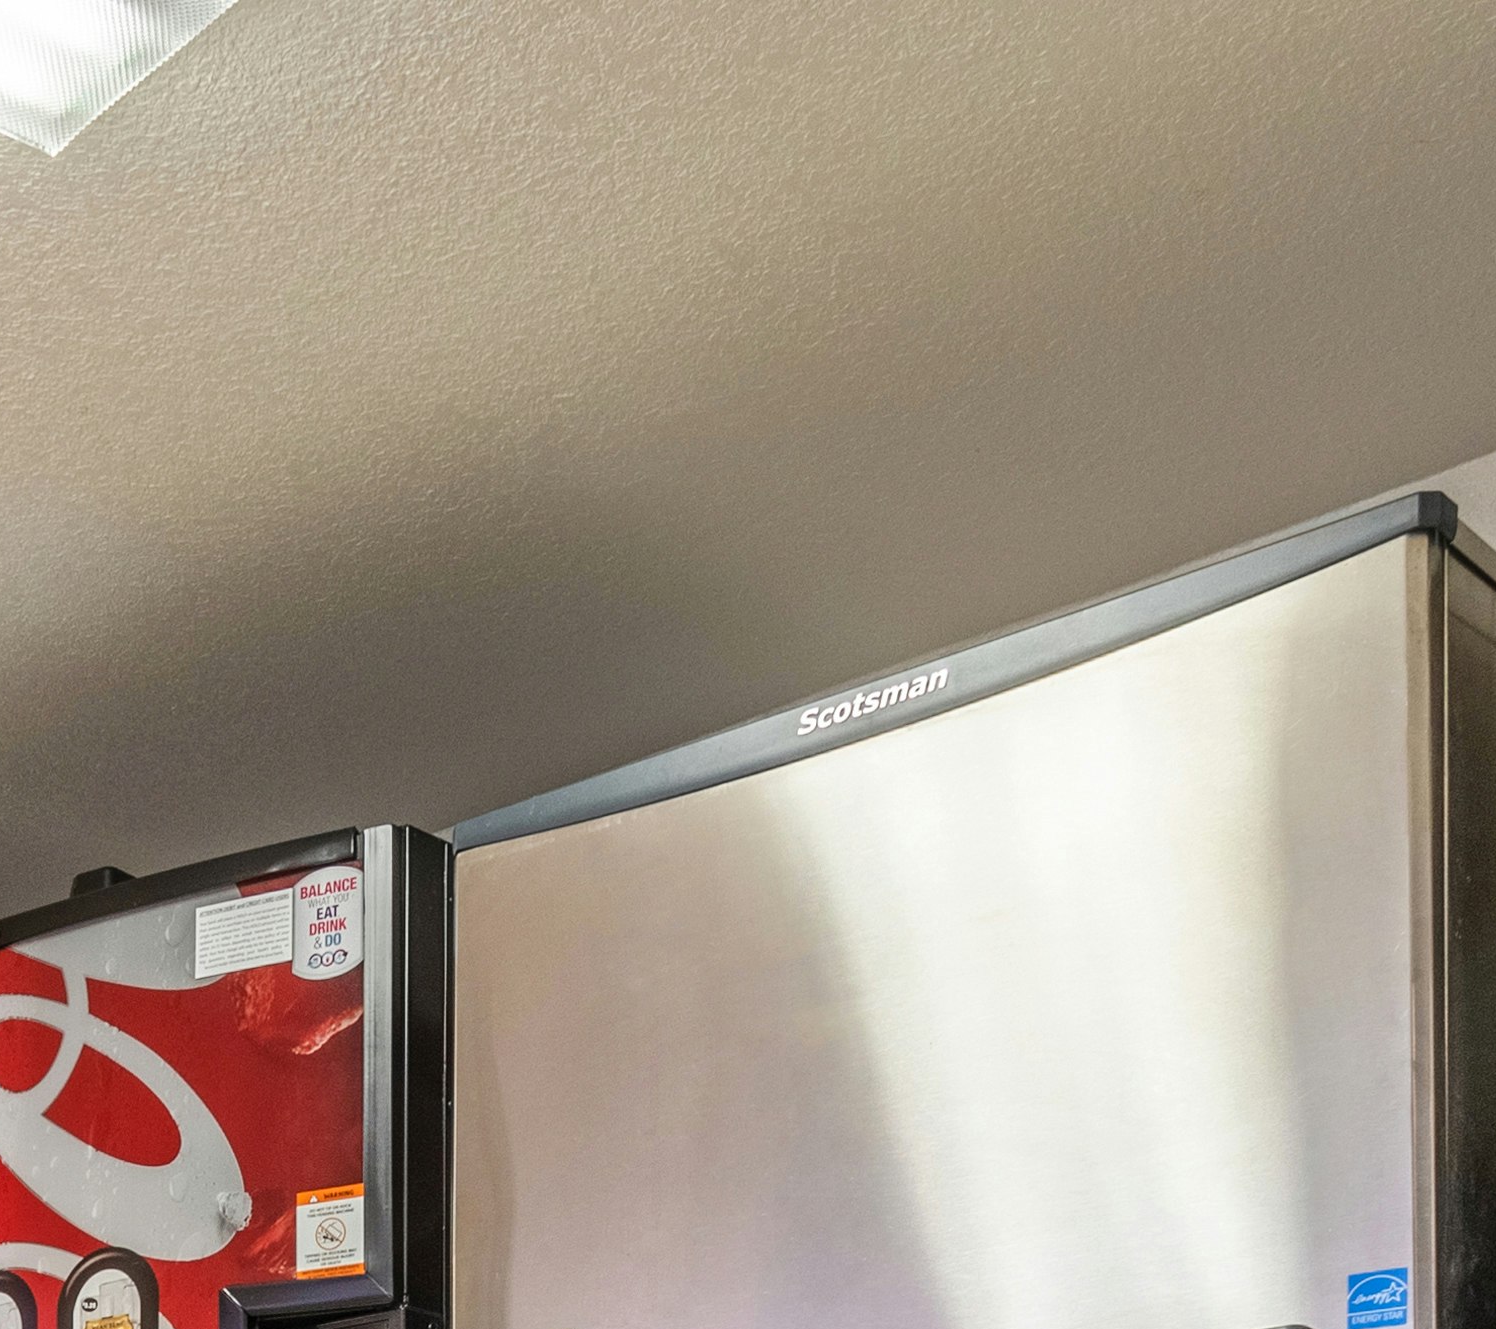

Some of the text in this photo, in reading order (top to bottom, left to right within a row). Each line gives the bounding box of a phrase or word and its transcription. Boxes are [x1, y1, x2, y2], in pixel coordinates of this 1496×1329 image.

[796, 667, 948, 736] Scotsman
[300, 877, 357, 900] BALANCE
[308, 897, 331, 909] WHAT
[317, 905, 339, 920] EAT
[309, 918, 347, 936] DRINK
[314, 933, 341, 949] & DO
[324, 1190, 354, 1199] WARNING
